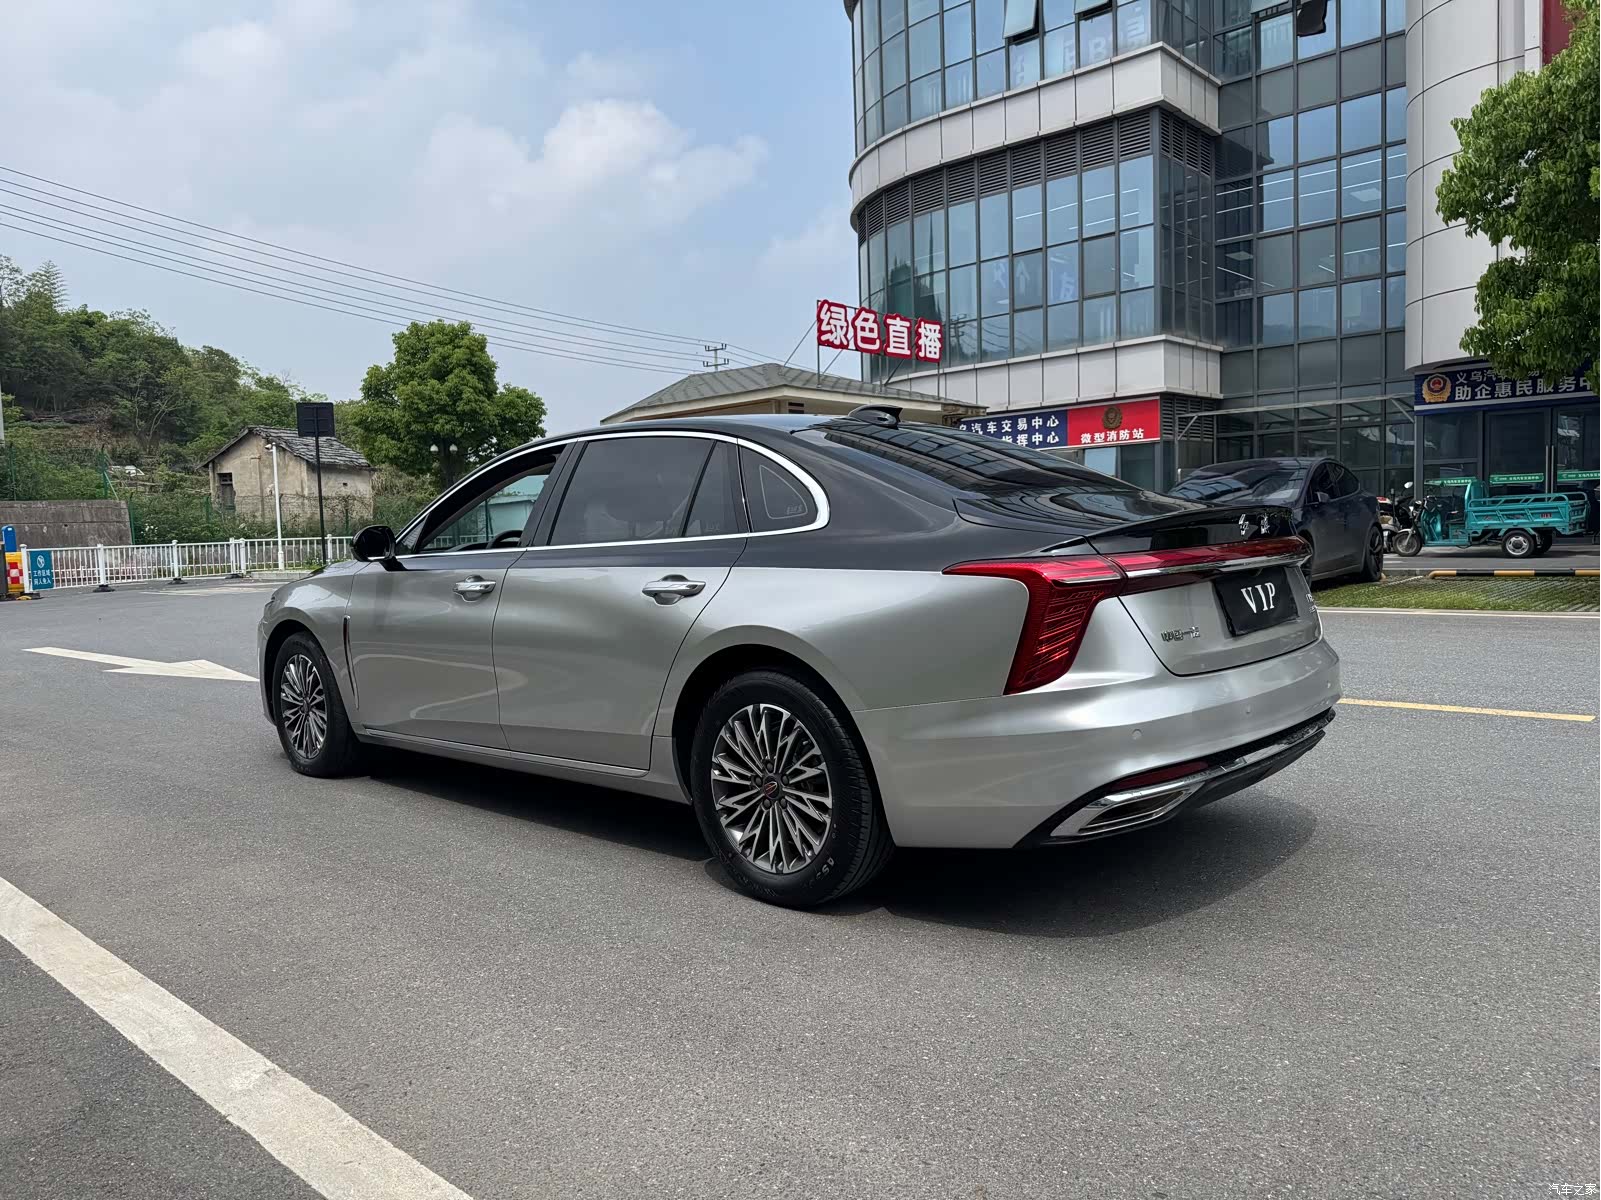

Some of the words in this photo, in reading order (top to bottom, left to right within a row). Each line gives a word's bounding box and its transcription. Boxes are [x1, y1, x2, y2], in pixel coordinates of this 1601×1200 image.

[819, 302, 942, 360] 绿色直播
[1080, 428, 1145, 444] 微型消防站
[1240, 582, 1276, 614] VIP
